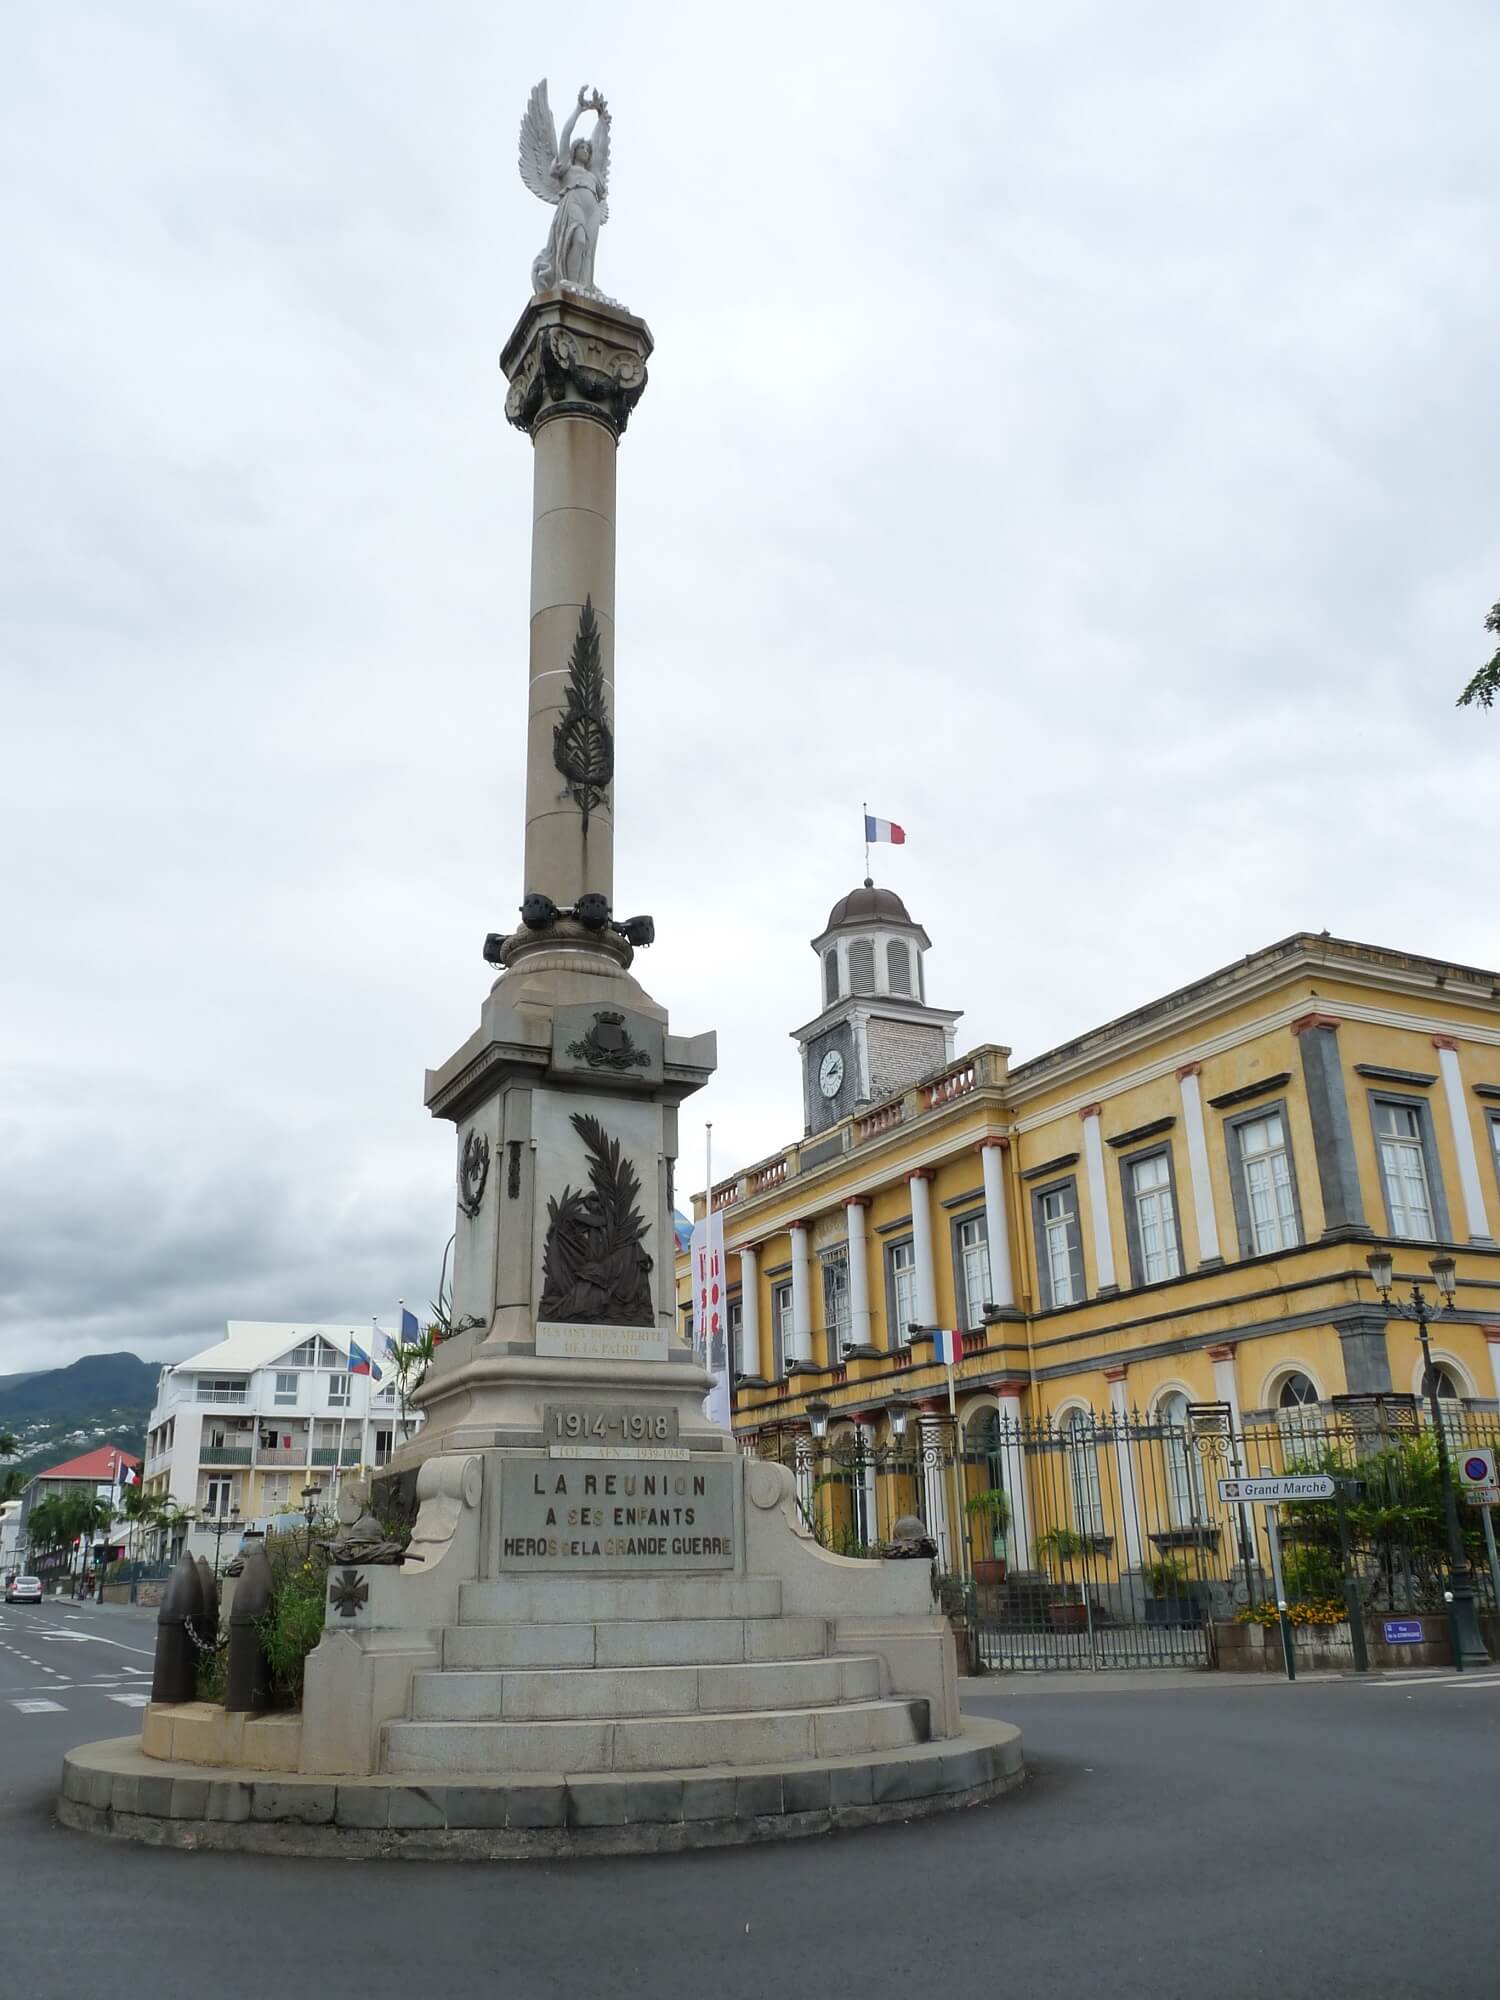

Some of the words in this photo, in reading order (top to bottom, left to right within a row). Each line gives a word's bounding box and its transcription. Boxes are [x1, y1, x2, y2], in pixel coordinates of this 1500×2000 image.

[554, 1412, 669, 1440] 1914-1918
[533, 1474, 568, 1496] LA
[585, 1474, 706, 1497] REUNION
[1244, 1483, 1280, 1496] Grand
[1283, 1480, 1327, 1494] Marché
[545, 1507, 557, 1526] A
[568, 1508, 604, 1527] SES
[614, 1507, 696, 1527] ENFANTS
[504, 1538, 557, 1557] HEROS
[605, 1538, 667, 1556] GRANDE
[671, 1537, 733, 1556] GUERRE
